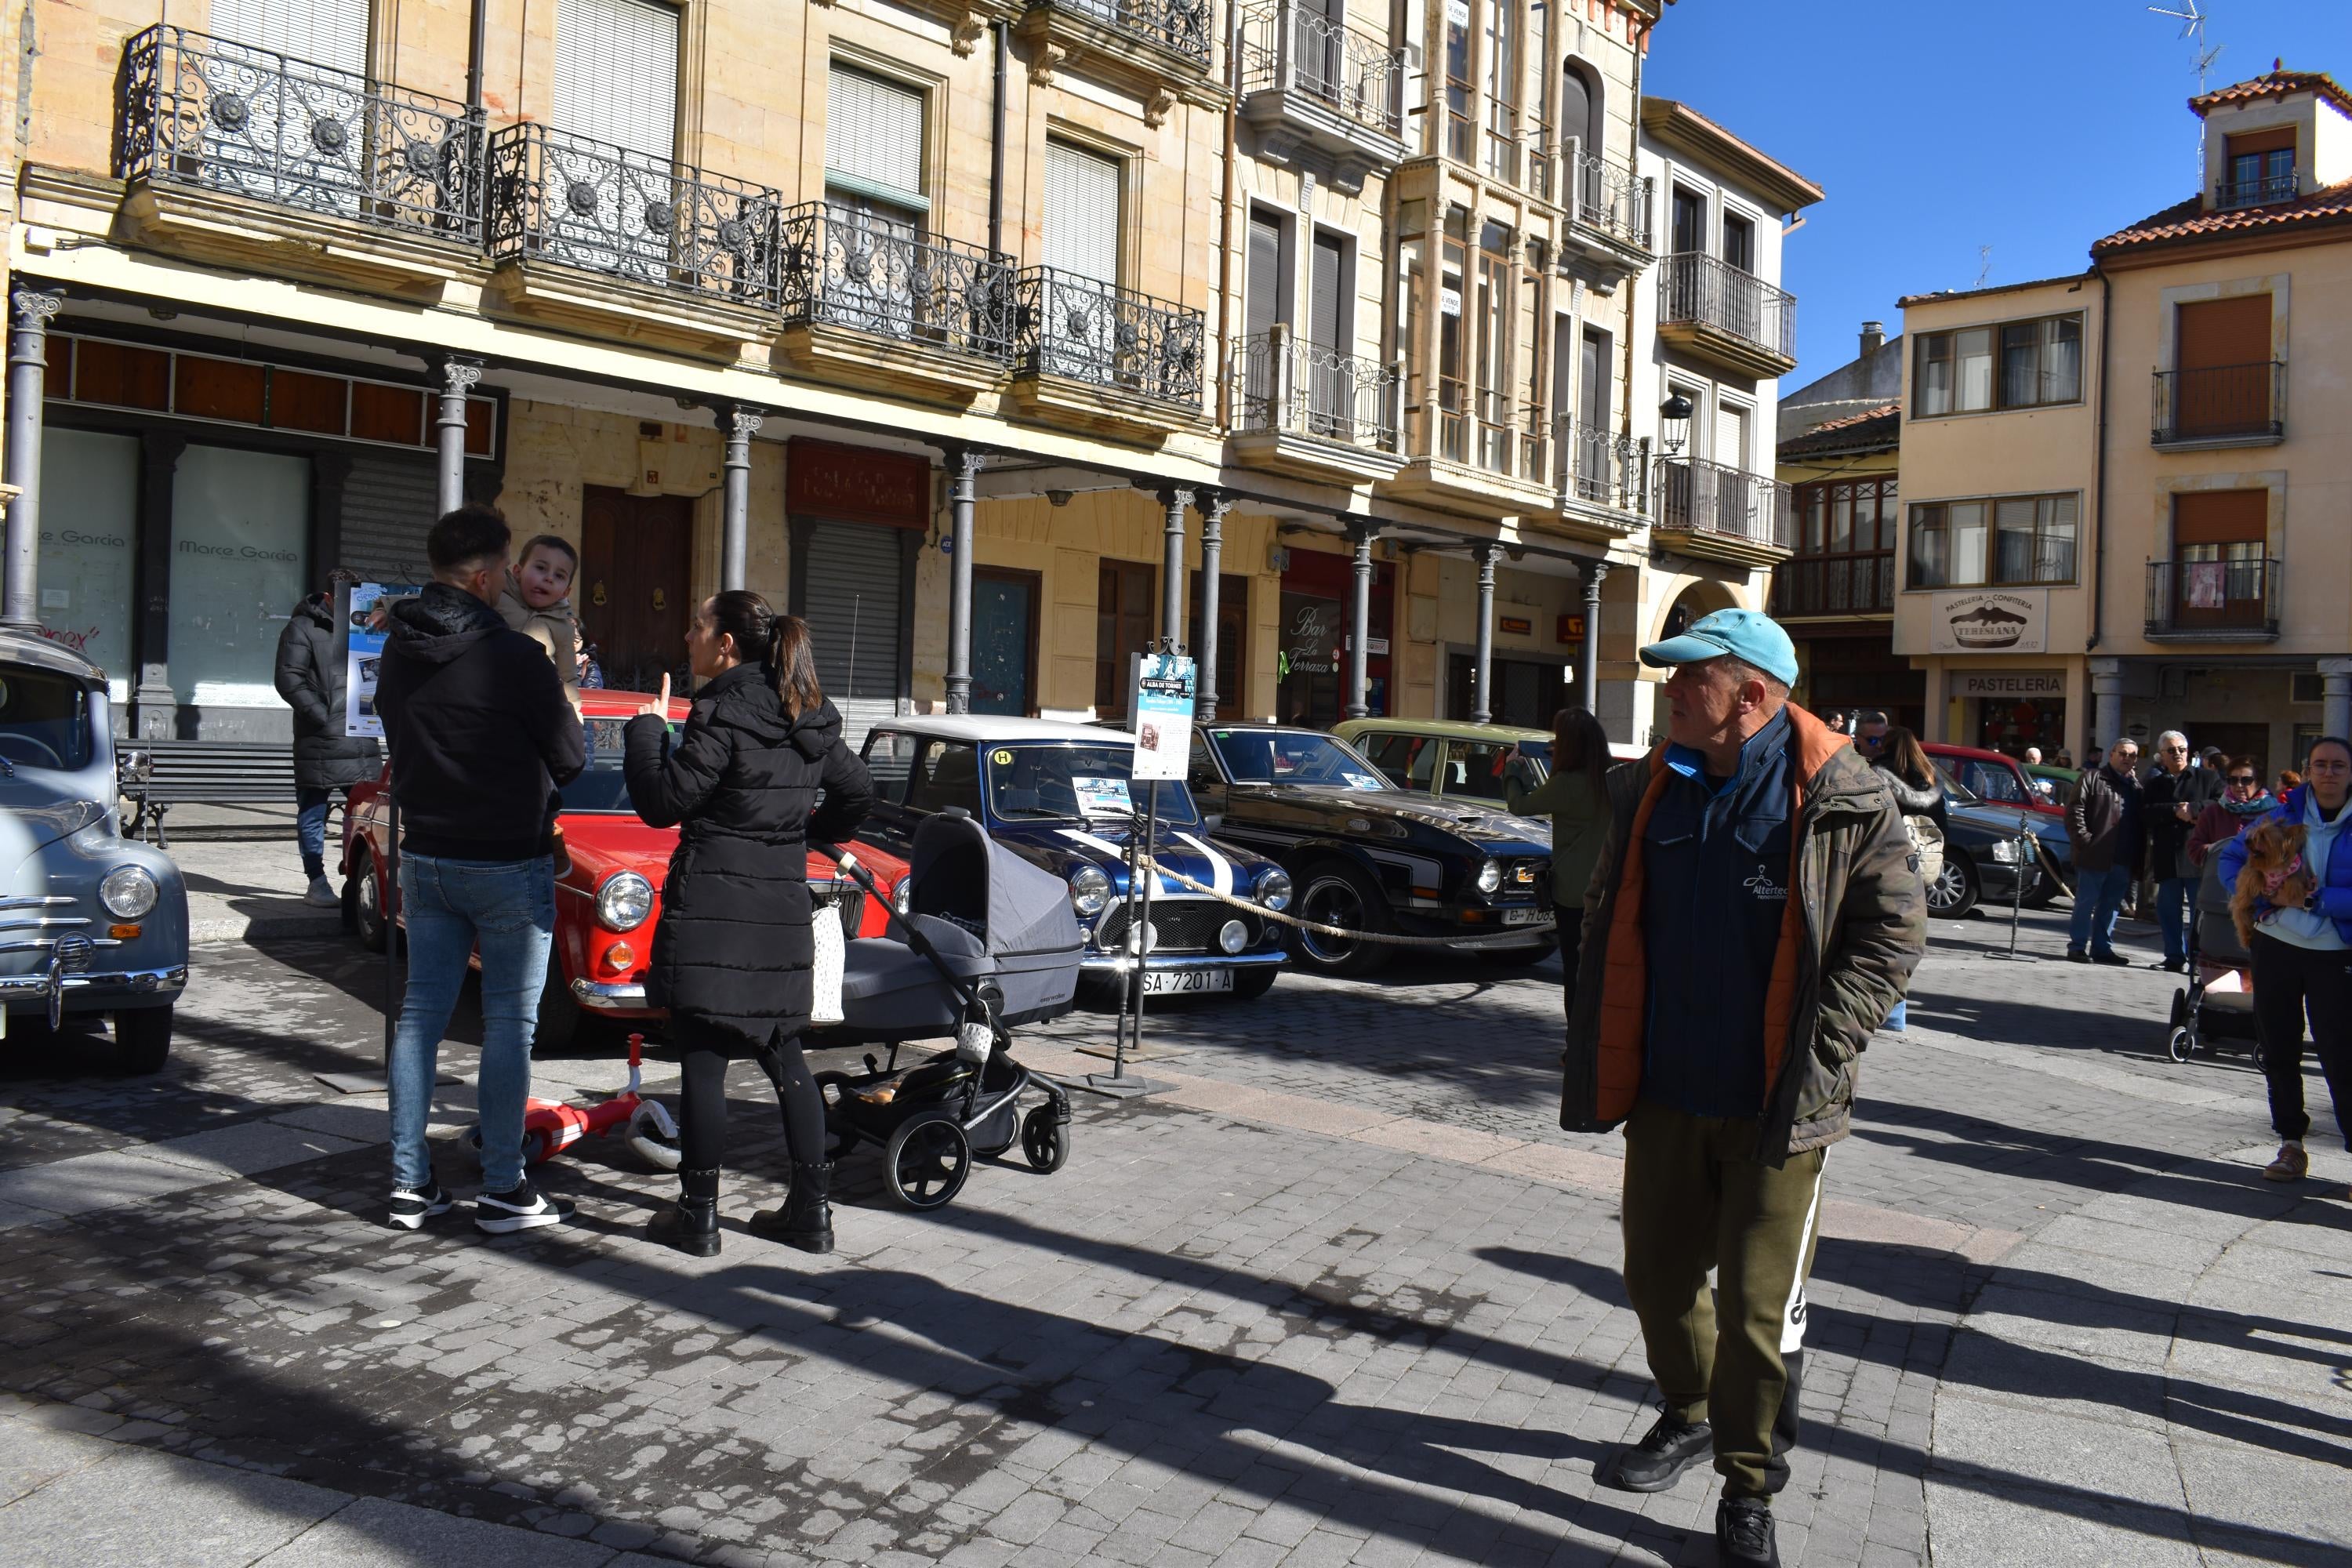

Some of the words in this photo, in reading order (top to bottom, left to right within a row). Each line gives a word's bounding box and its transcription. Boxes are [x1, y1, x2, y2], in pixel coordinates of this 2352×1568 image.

[1446, 297, 1459, 307] VENDE
[179, 540, 234, 556] Marce
[240, 546, 298, 562] Garcia
[1946, 595, 1984, 612] PASTELERIA
[1993, 593, 2033, 611] CONFITERIA
[1290, 606, 1327, 637] Bar
[1958, 626, 2017, 636] TERESIANA
[1305, 638, 1319, 656] La
[1289, 647, 1330, 673] Terraza
[1968, 676, 2061, 691] PASTELERÍA
[998, 753, 1008, 763] H
[1040, 993, 1065, 1003] easywalker
